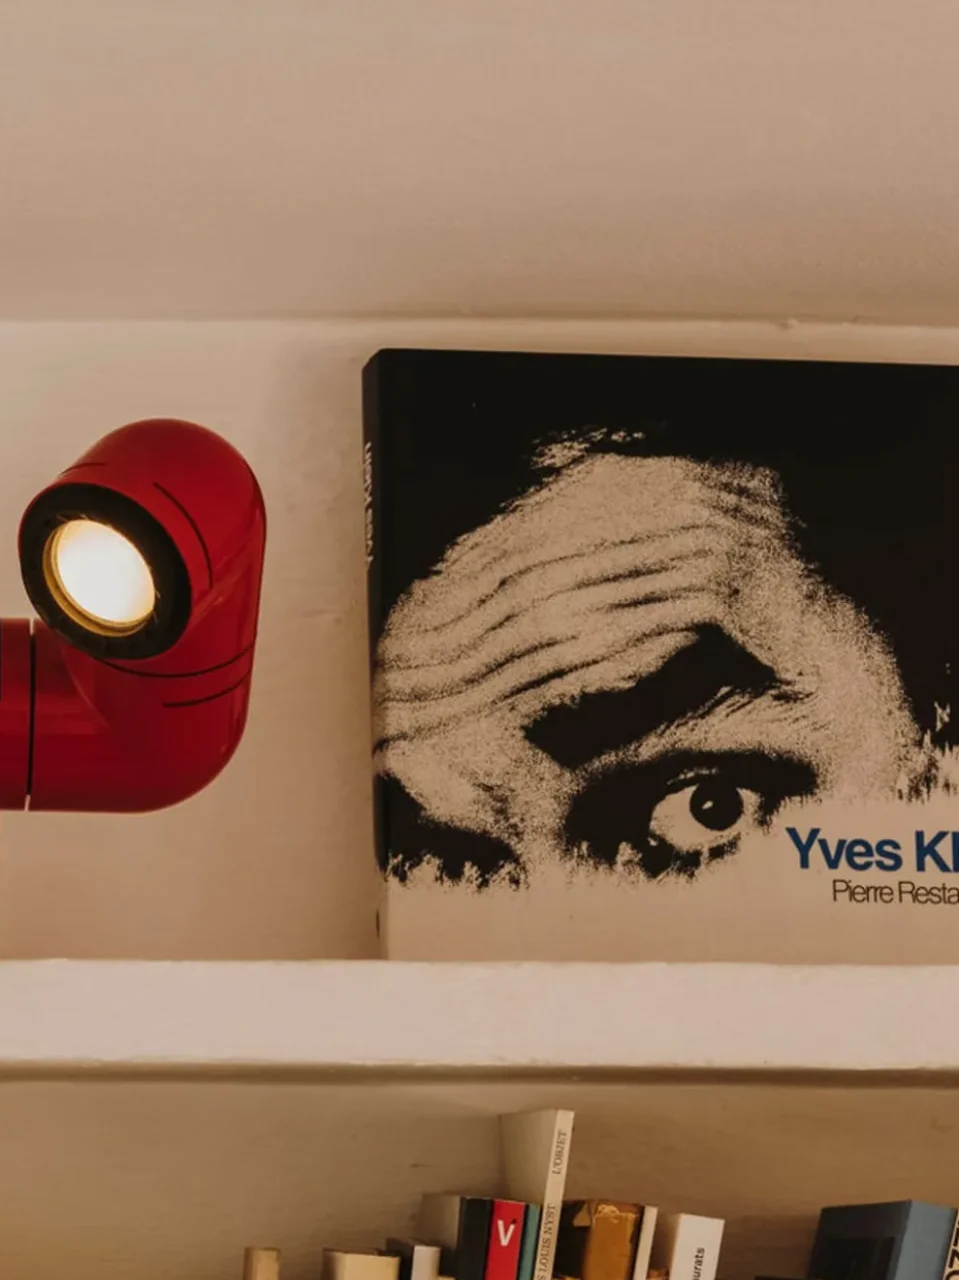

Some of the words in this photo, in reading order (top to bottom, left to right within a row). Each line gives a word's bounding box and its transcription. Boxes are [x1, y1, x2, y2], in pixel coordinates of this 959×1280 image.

[786, 827, 903, 871] Yves
[832, 879, 895, 904] Pierre
[542, 1203, 556, 1235] NYST
[537, 1238, 552, 1273] LOUIS
